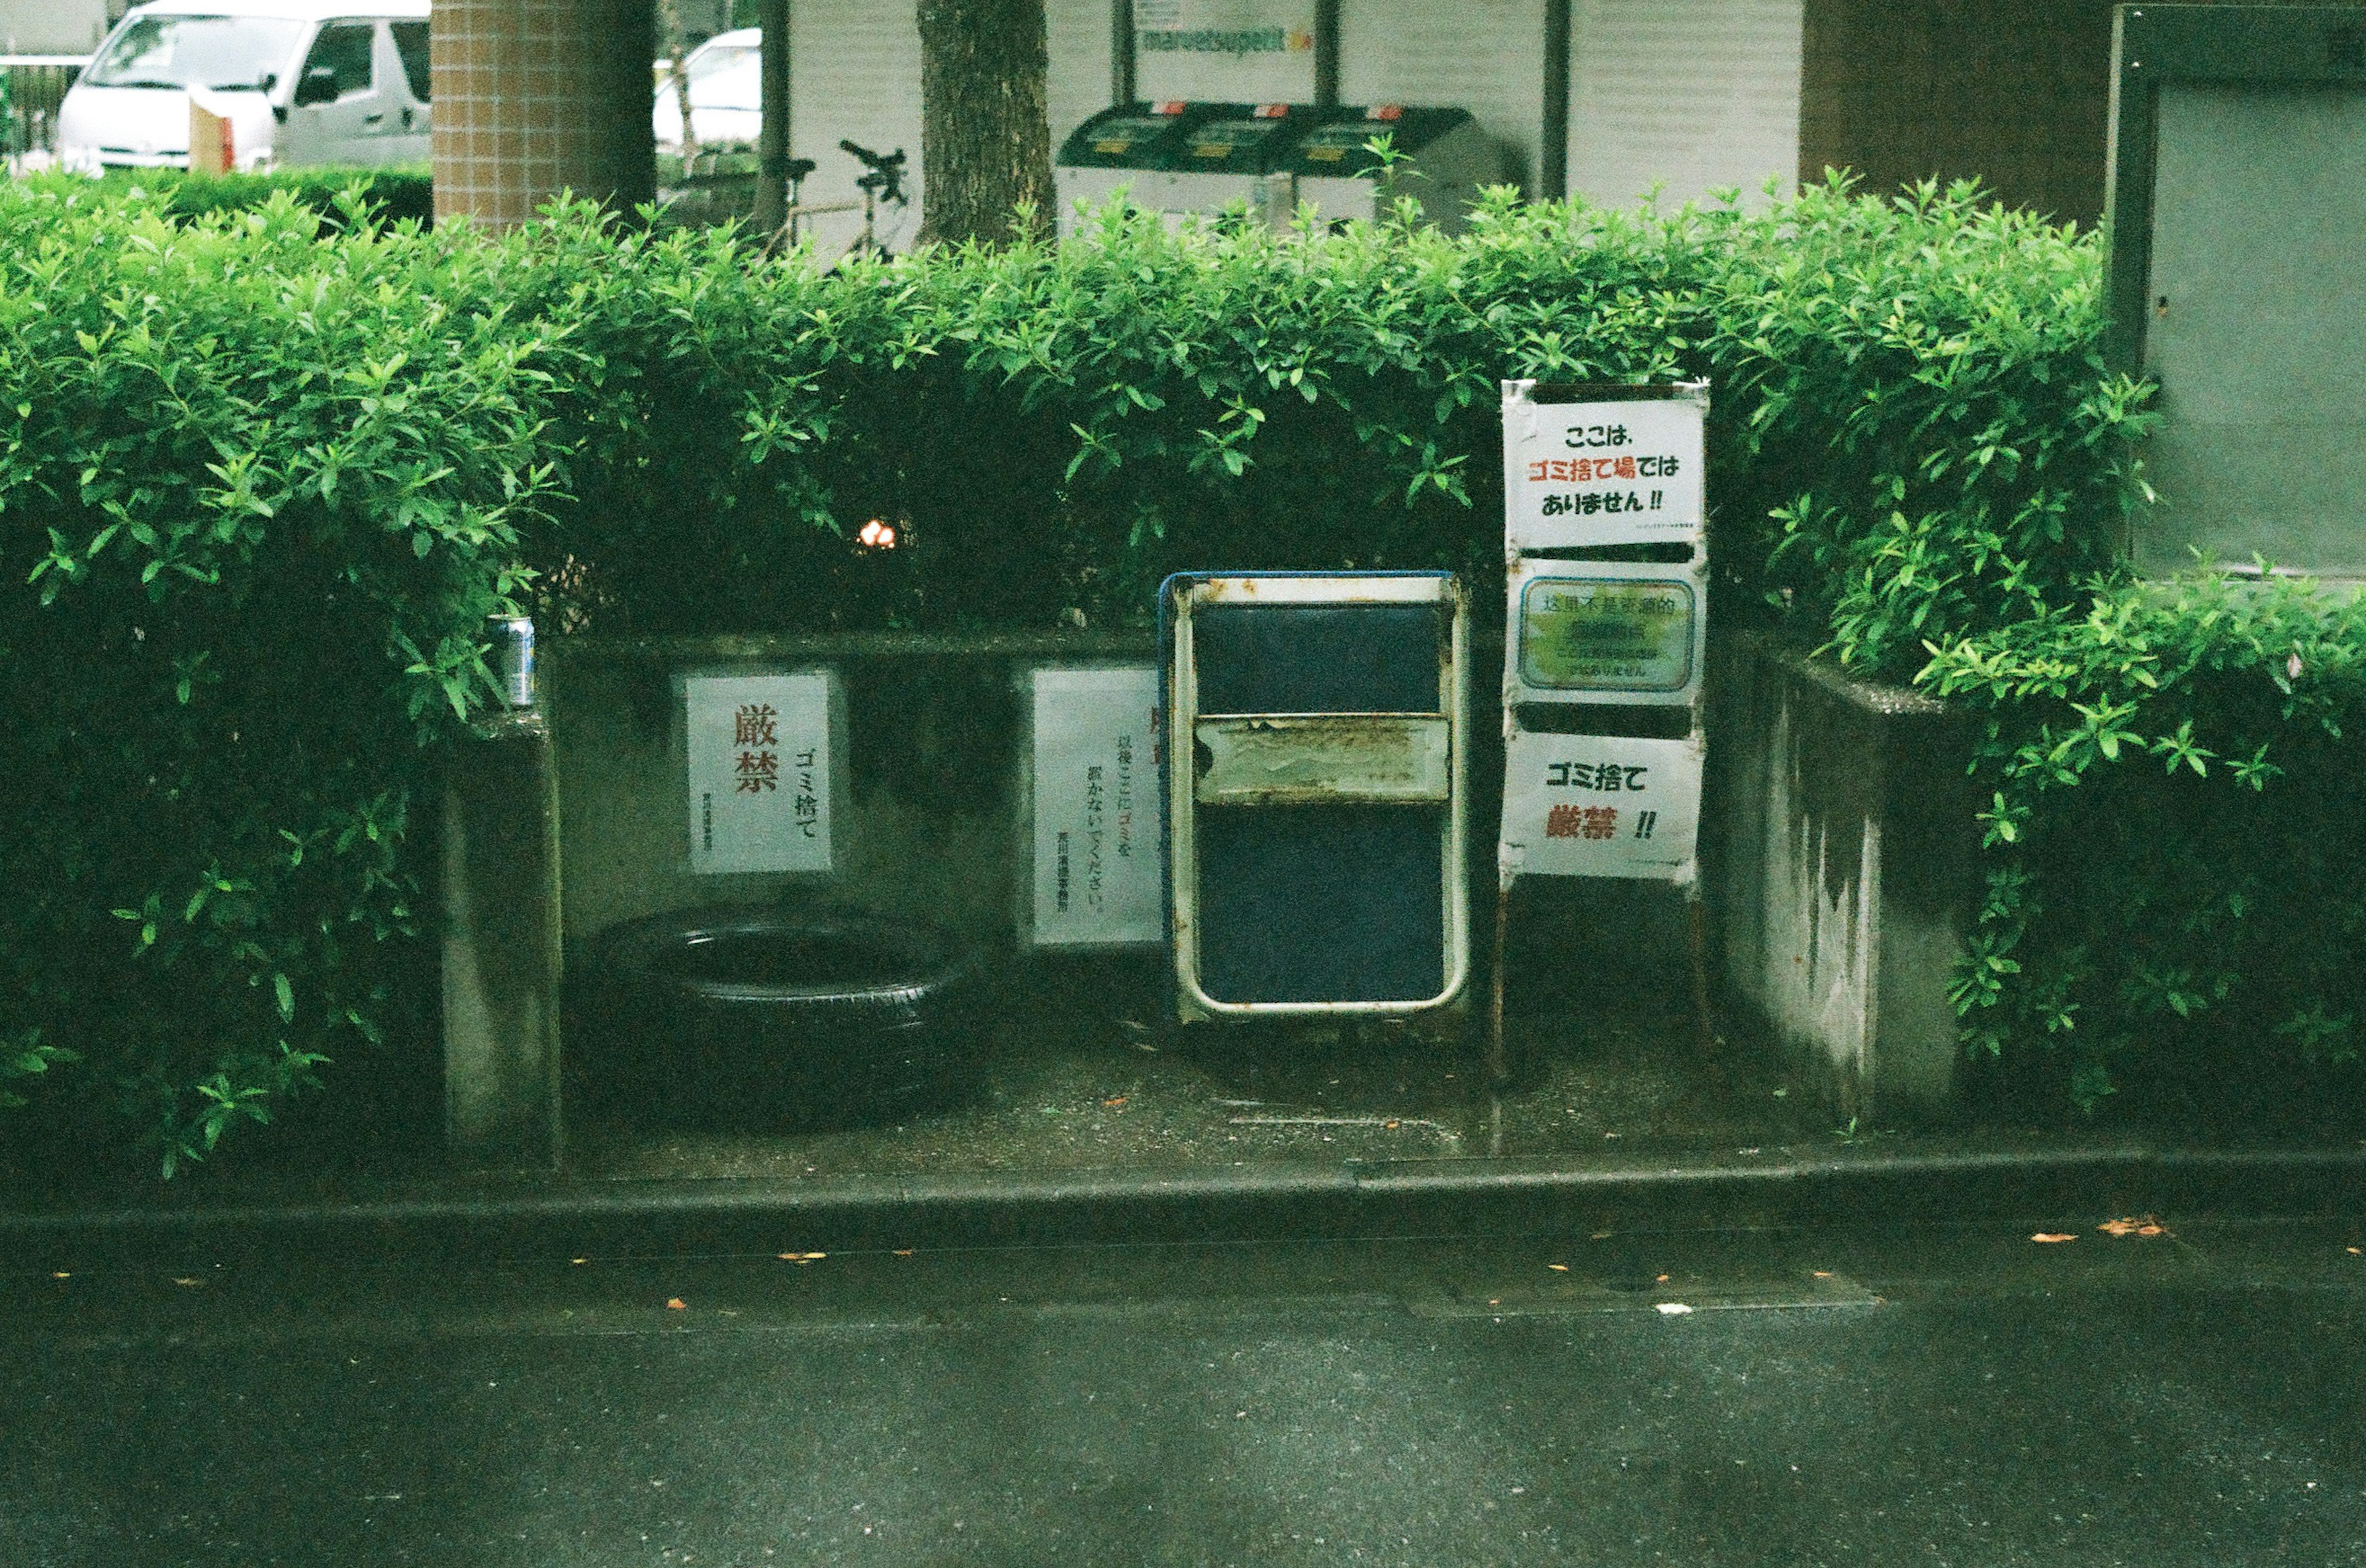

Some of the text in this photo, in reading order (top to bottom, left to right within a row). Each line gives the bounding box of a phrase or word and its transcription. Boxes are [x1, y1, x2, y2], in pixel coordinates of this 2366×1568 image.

[1529, 456, 1679, 482] ゴミ捨て場では
[734, 704, 778, 794] 厳禁
[794, 748, 818, 838] ゴミ捨て
[1547, 762, 1648, 790] ゴミ捨て
[1117, 736, 1132, 857] 以後ここにゴミを
